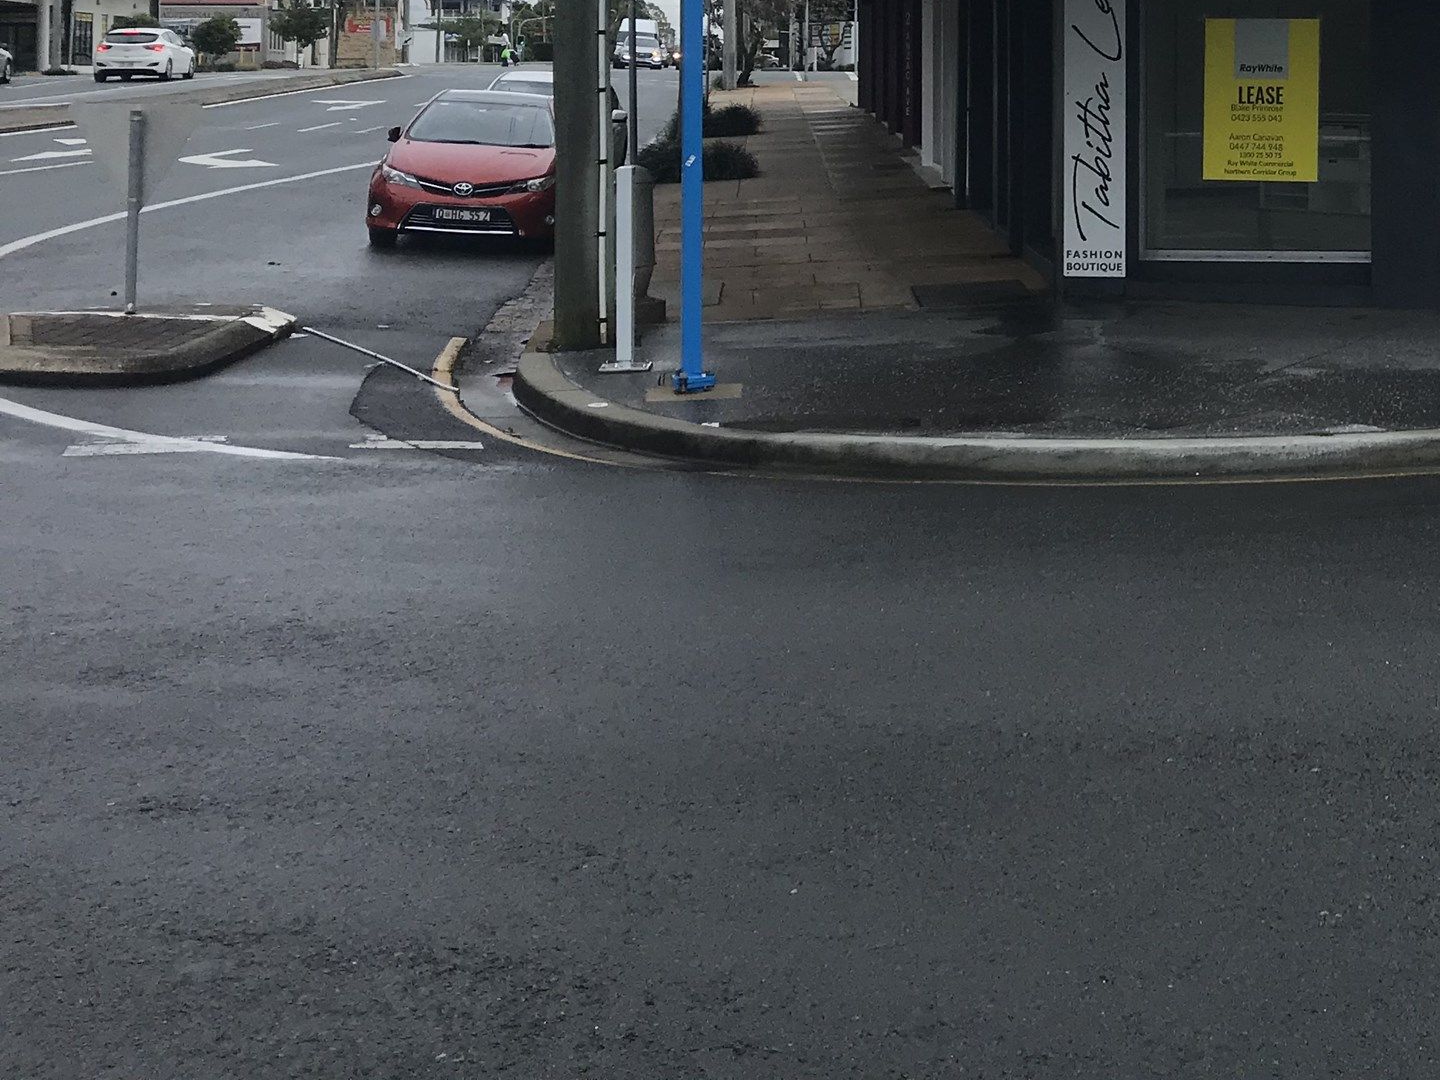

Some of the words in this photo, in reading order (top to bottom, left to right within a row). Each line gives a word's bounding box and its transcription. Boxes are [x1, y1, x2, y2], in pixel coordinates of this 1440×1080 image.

[1238, 86, 1284, 105] LEASE
[1071, 72, 1120, 241] Tabitha
[1066, 250, 1122, 259] FASHION
[1066, 262, 1123, 272] BOUTIQUE
